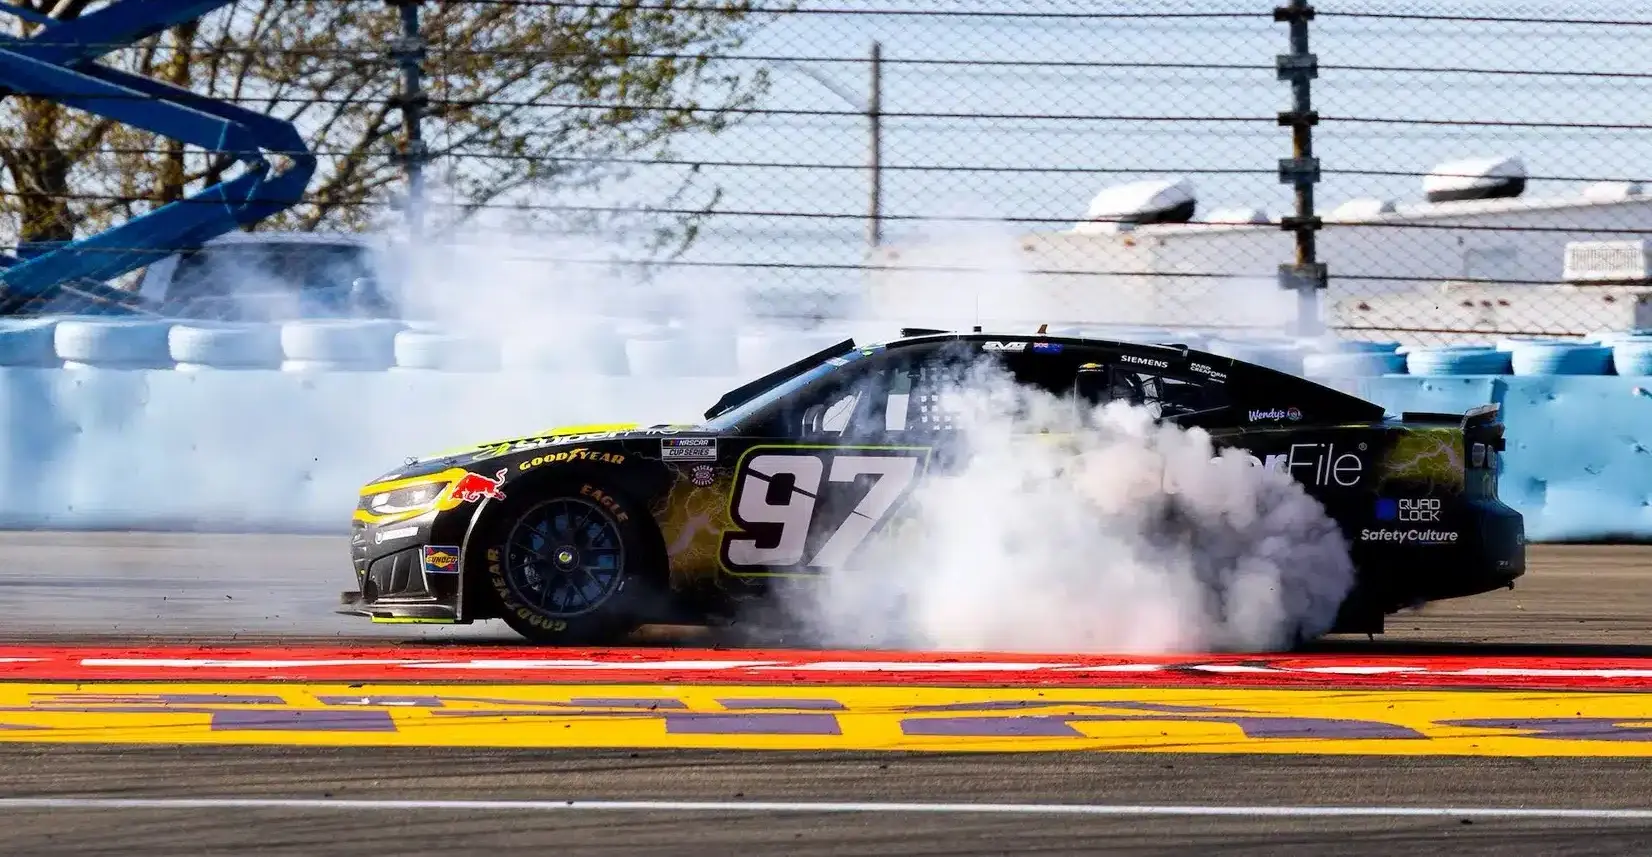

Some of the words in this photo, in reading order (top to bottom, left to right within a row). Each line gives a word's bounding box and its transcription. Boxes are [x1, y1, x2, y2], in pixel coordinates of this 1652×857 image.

[1120, 354, 1168, 368] SIEMENS
[1248, 408, 1285, 422] Wendy's
[669, 448, 684, 456] CUP
[684, 448, 709, 456] SERIES
[519, 448, 625, 471] GOODYEAR
[580, 483, 628, 522] EAGLE
[1399, 499, 1440, 510] QUAD
[728, 455, 917, 566] 97
[1399, 510, 1440, 521] LOCK
[1360, 529, 1458, 544] SafetyCulture
[426, 555, 458, 564] SUNOCO
